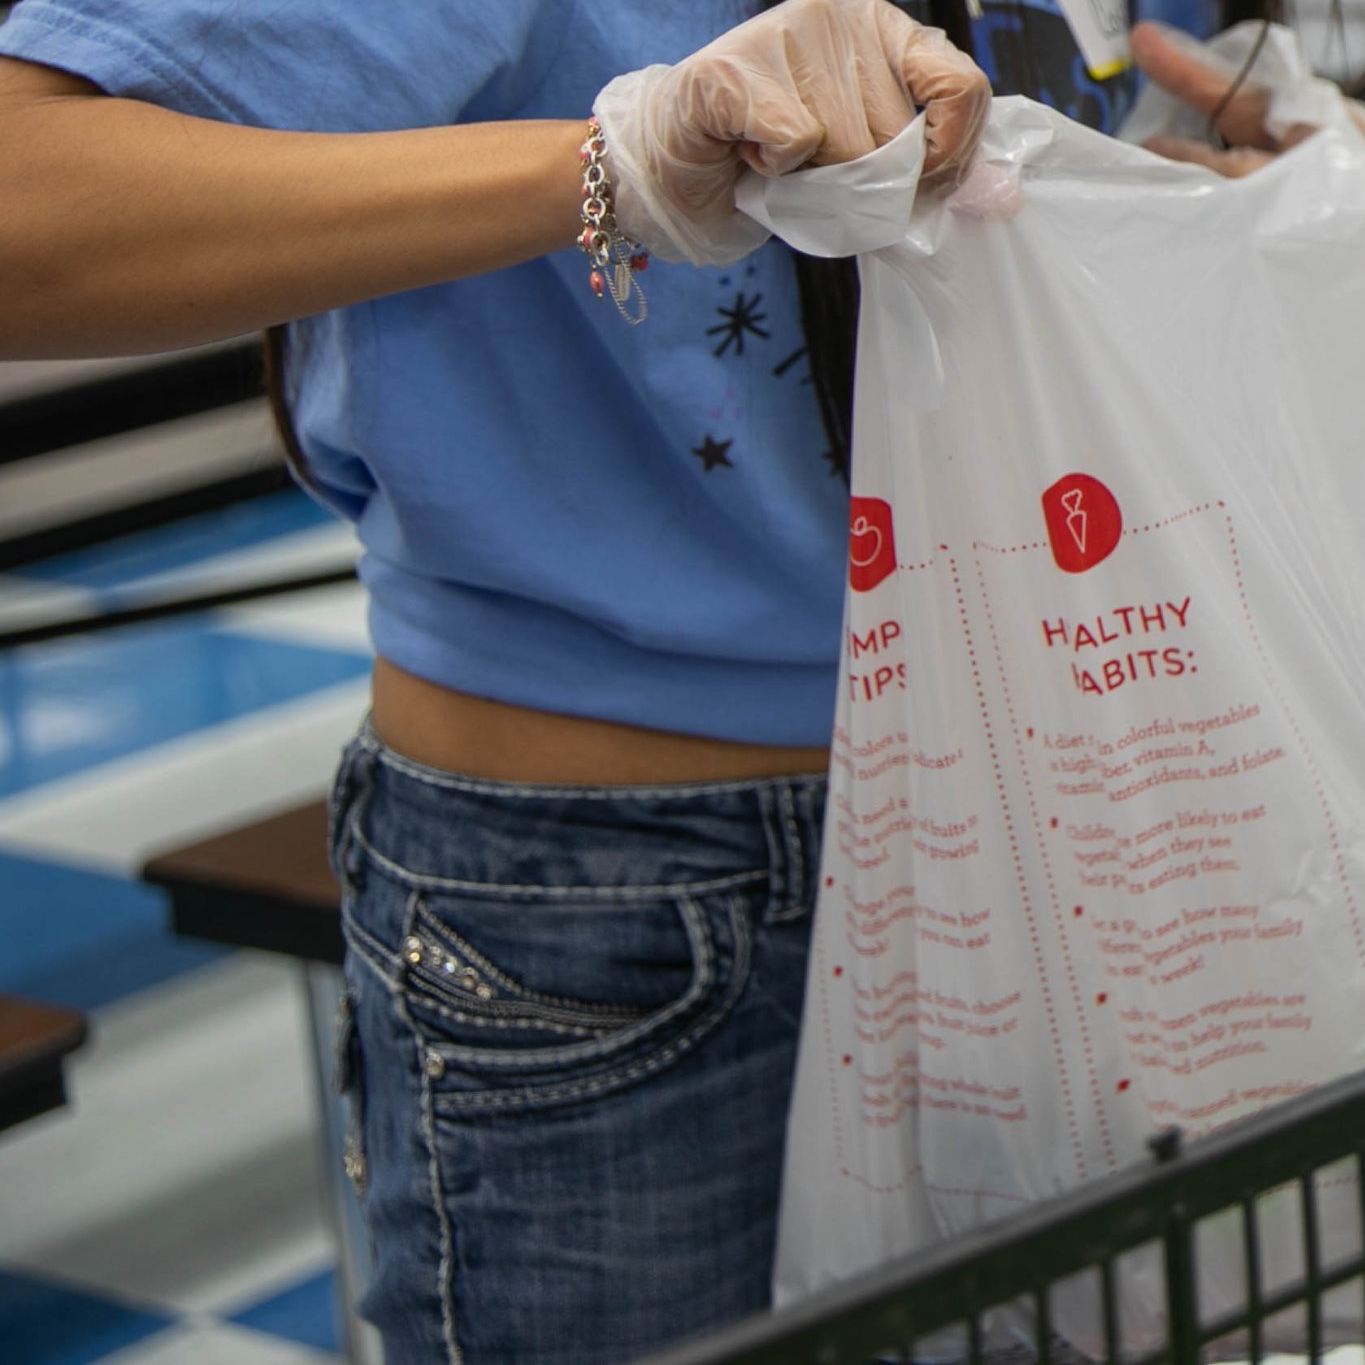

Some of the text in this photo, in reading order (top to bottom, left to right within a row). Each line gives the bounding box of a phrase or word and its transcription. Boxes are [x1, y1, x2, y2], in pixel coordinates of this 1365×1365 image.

[1041, 596, 1191, 652] HALTHY
[1116, 717, 1175, 751] colorful
[1177, 702, 1261, 734] vegetables
[1133, 743, 1194, 767] vitamin
[1197, 739, 1216, 756] A,
[1208, 758, 1239, 778] and
